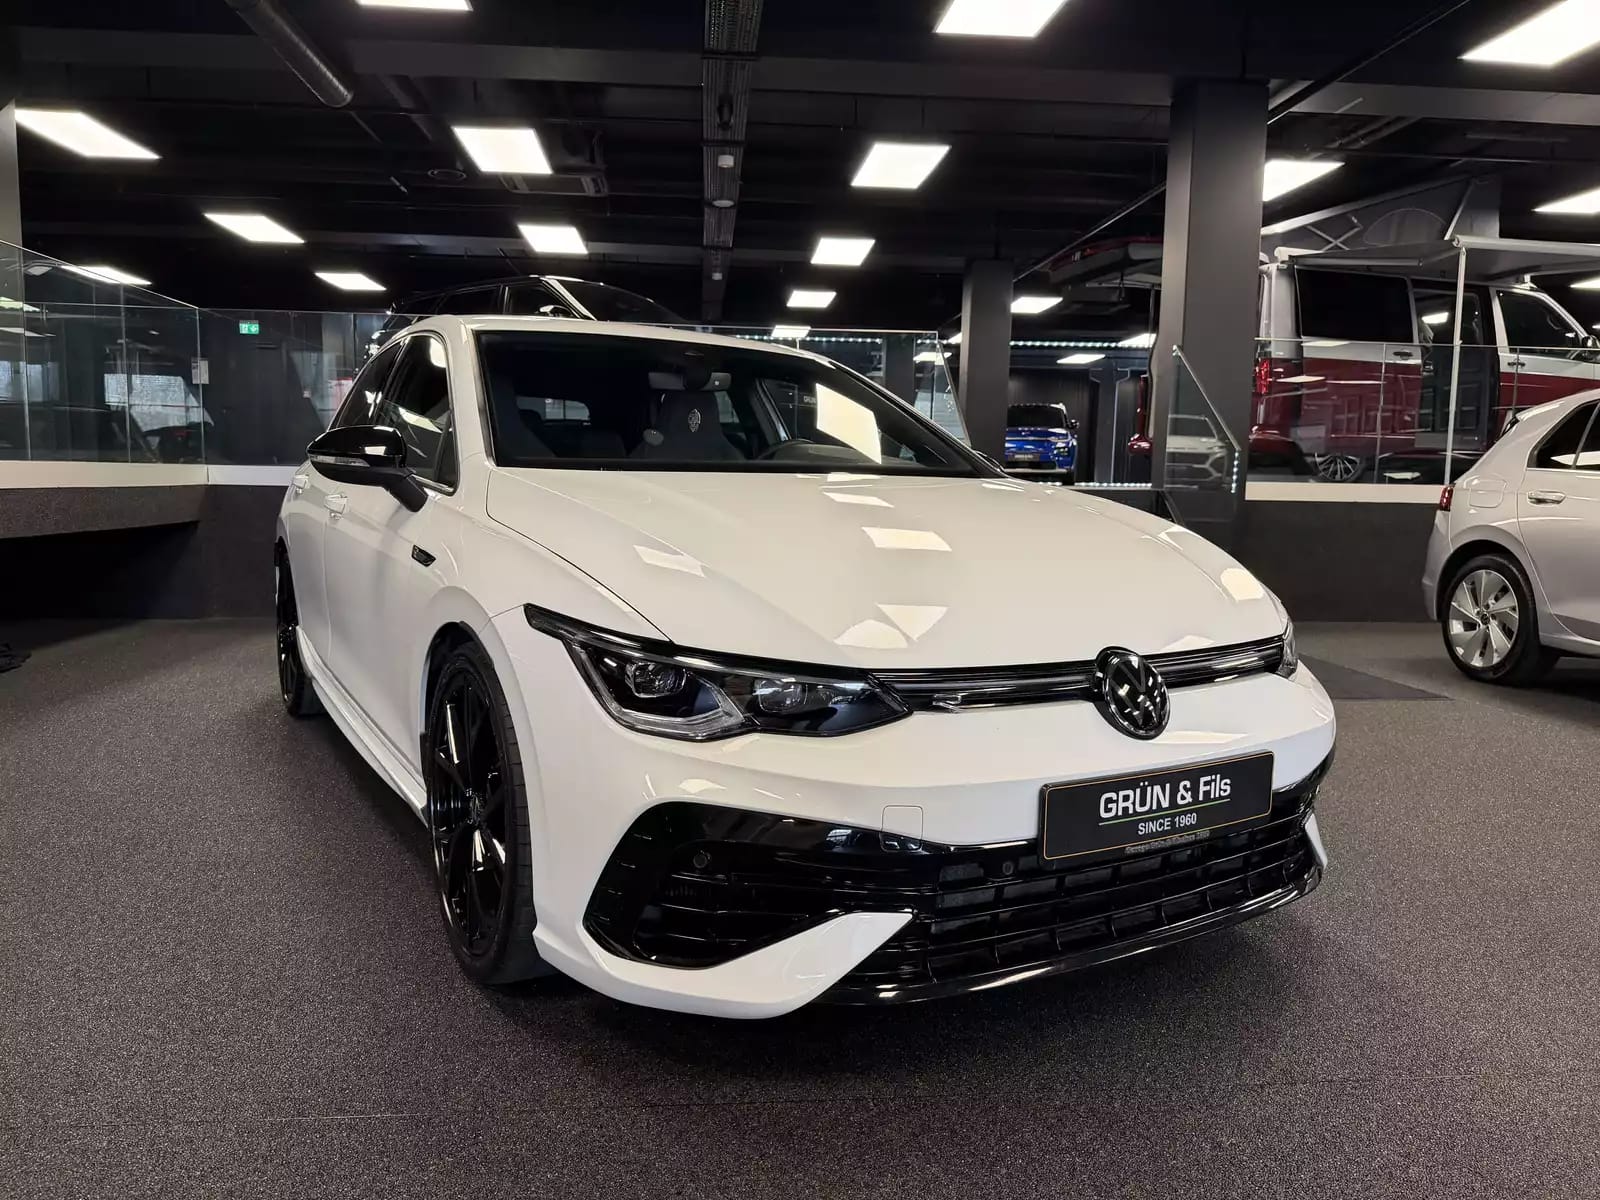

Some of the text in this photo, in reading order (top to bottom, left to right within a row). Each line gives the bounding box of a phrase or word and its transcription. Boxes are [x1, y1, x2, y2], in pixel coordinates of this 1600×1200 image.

[1099, 774, 1231, 819] GRÜN & Fils
[1137, 812, 1197, 836] SINCE 1960
